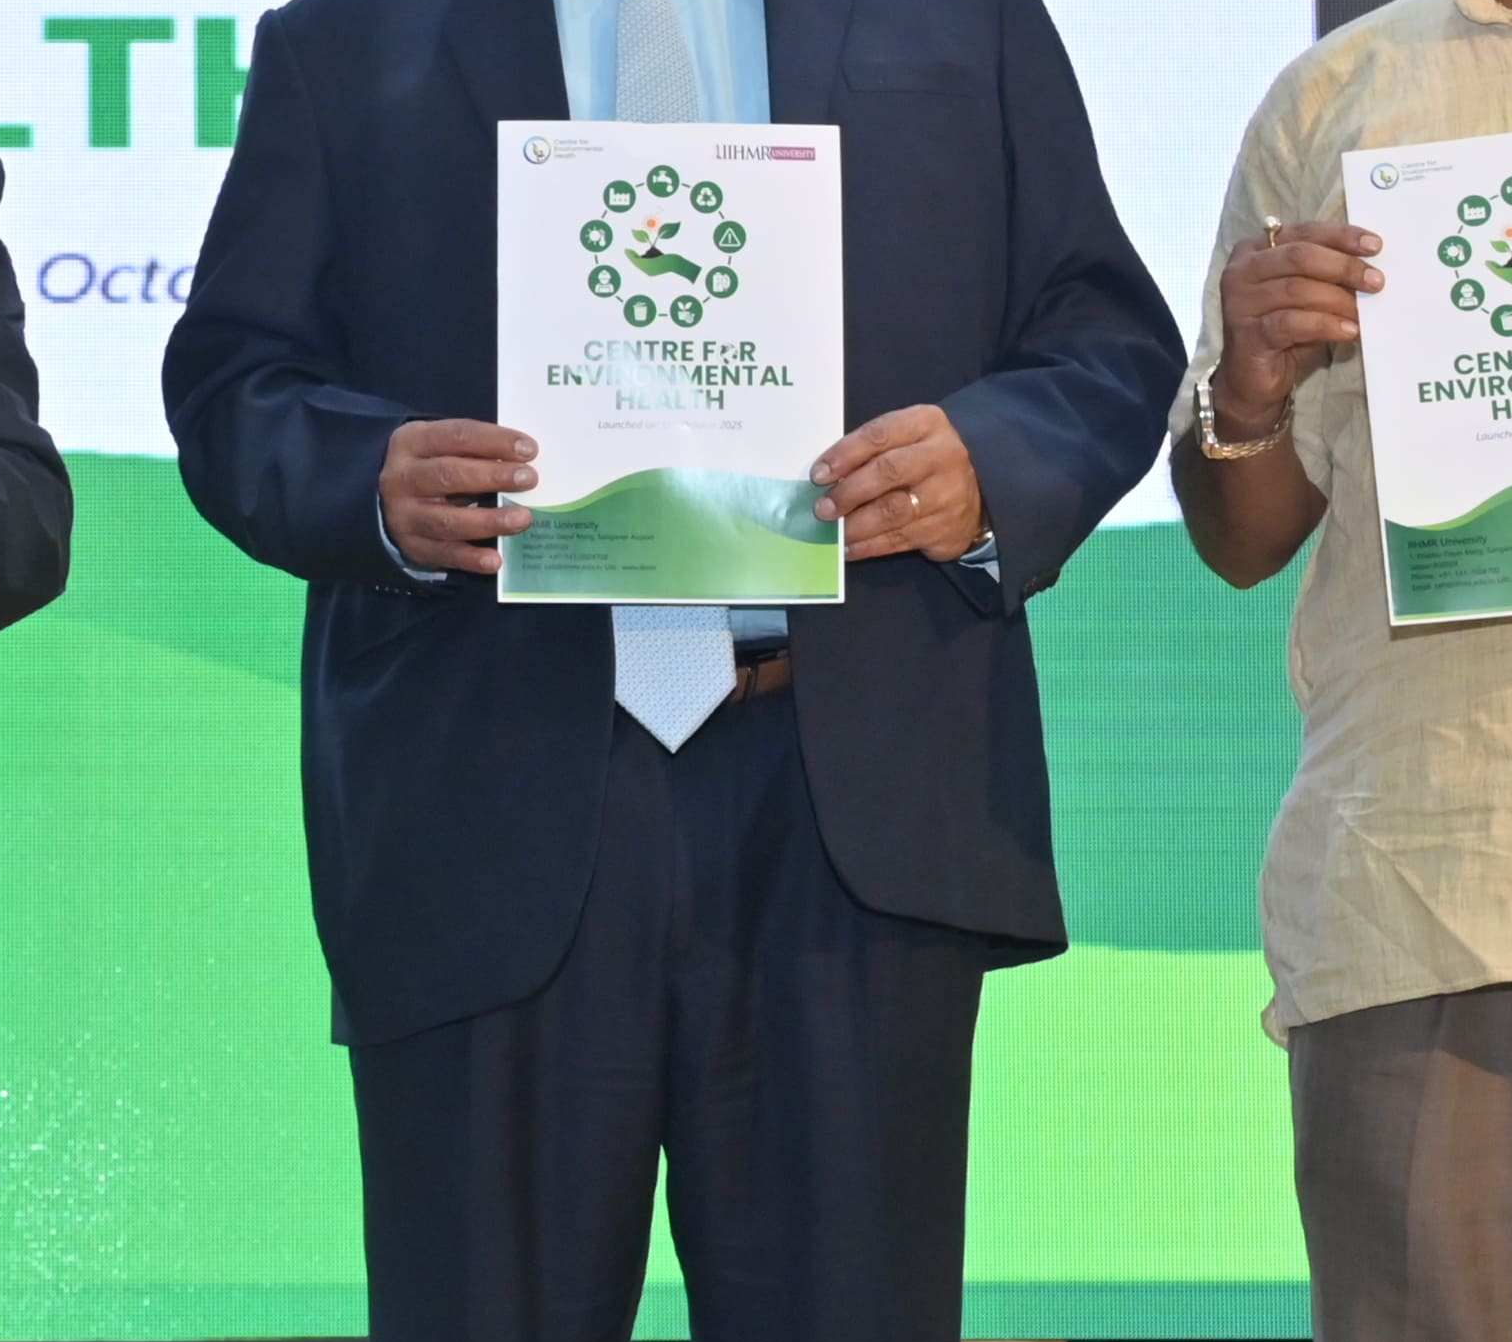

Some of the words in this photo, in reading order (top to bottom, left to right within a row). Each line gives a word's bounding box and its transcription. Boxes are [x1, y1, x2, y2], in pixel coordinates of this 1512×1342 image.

[771, 147, 815, 159] UNIVERSITY
[583, 340, 695, 362] CENTRE
[616, 389, 725, 411] HEALTH
[598, 420, 643, 430] Launched
[720, 420, 743, 430] 2025
[1440, 535, 1487, 547] University
